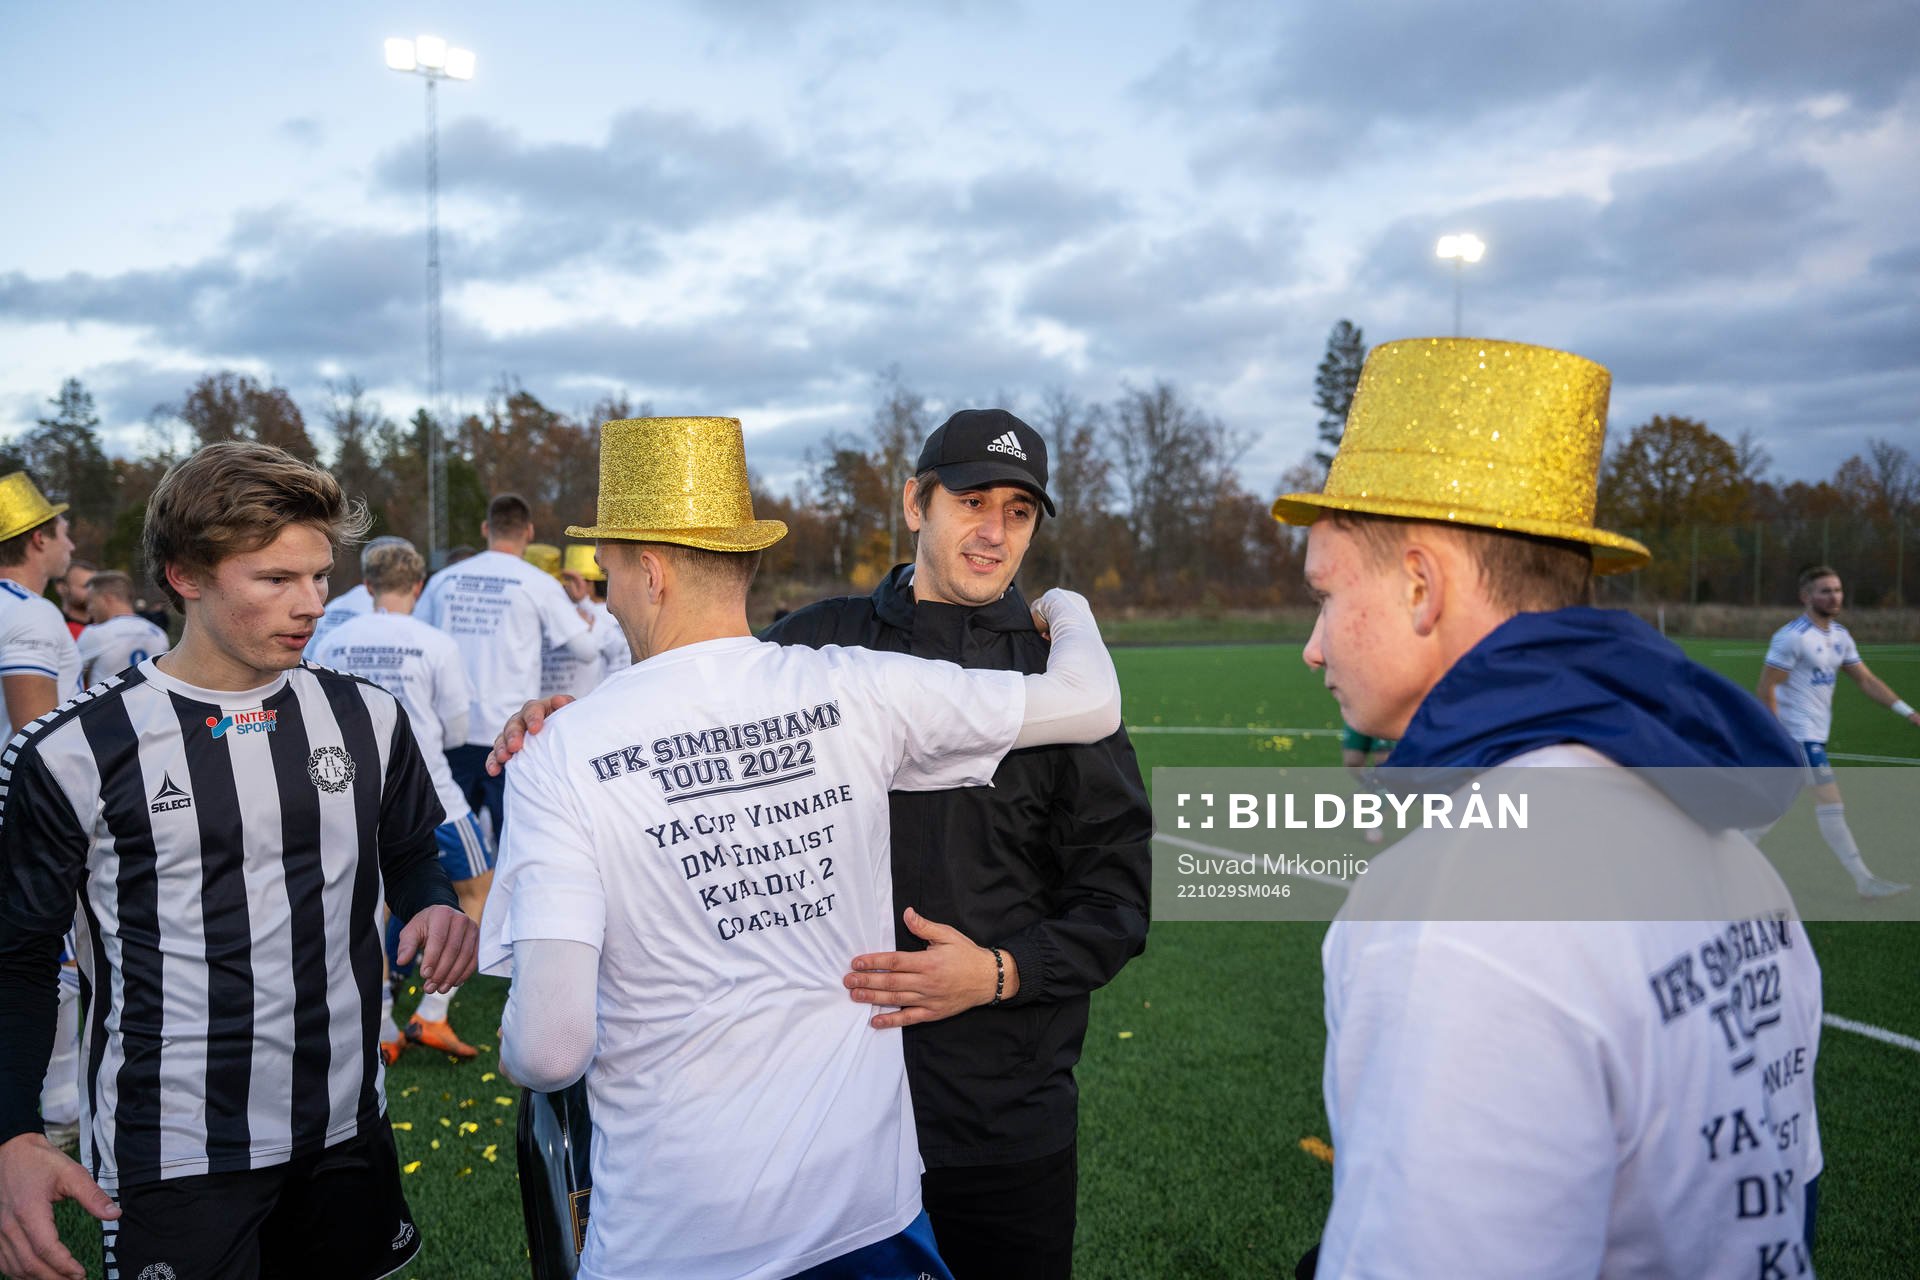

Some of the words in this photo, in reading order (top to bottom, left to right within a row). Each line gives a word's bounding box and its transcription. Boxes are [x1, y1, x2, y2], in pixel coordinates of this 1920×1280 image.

[987, 443, 1027, 461] adidas
[235, 709, 277, 725] INTER
[236, 719, 278, 735] SPORT
[589, 744, 650, 783] IFK
[651, 700, 842, 765] SIMRISHAMN
[651, 757, 735, 793] TOUR
[739, 738, 817, 780] 2022
[151, 797, 192, 814] SELECT
[744, 784, 853, 828] VINNARE
[819, 857, 834, 880] 2
